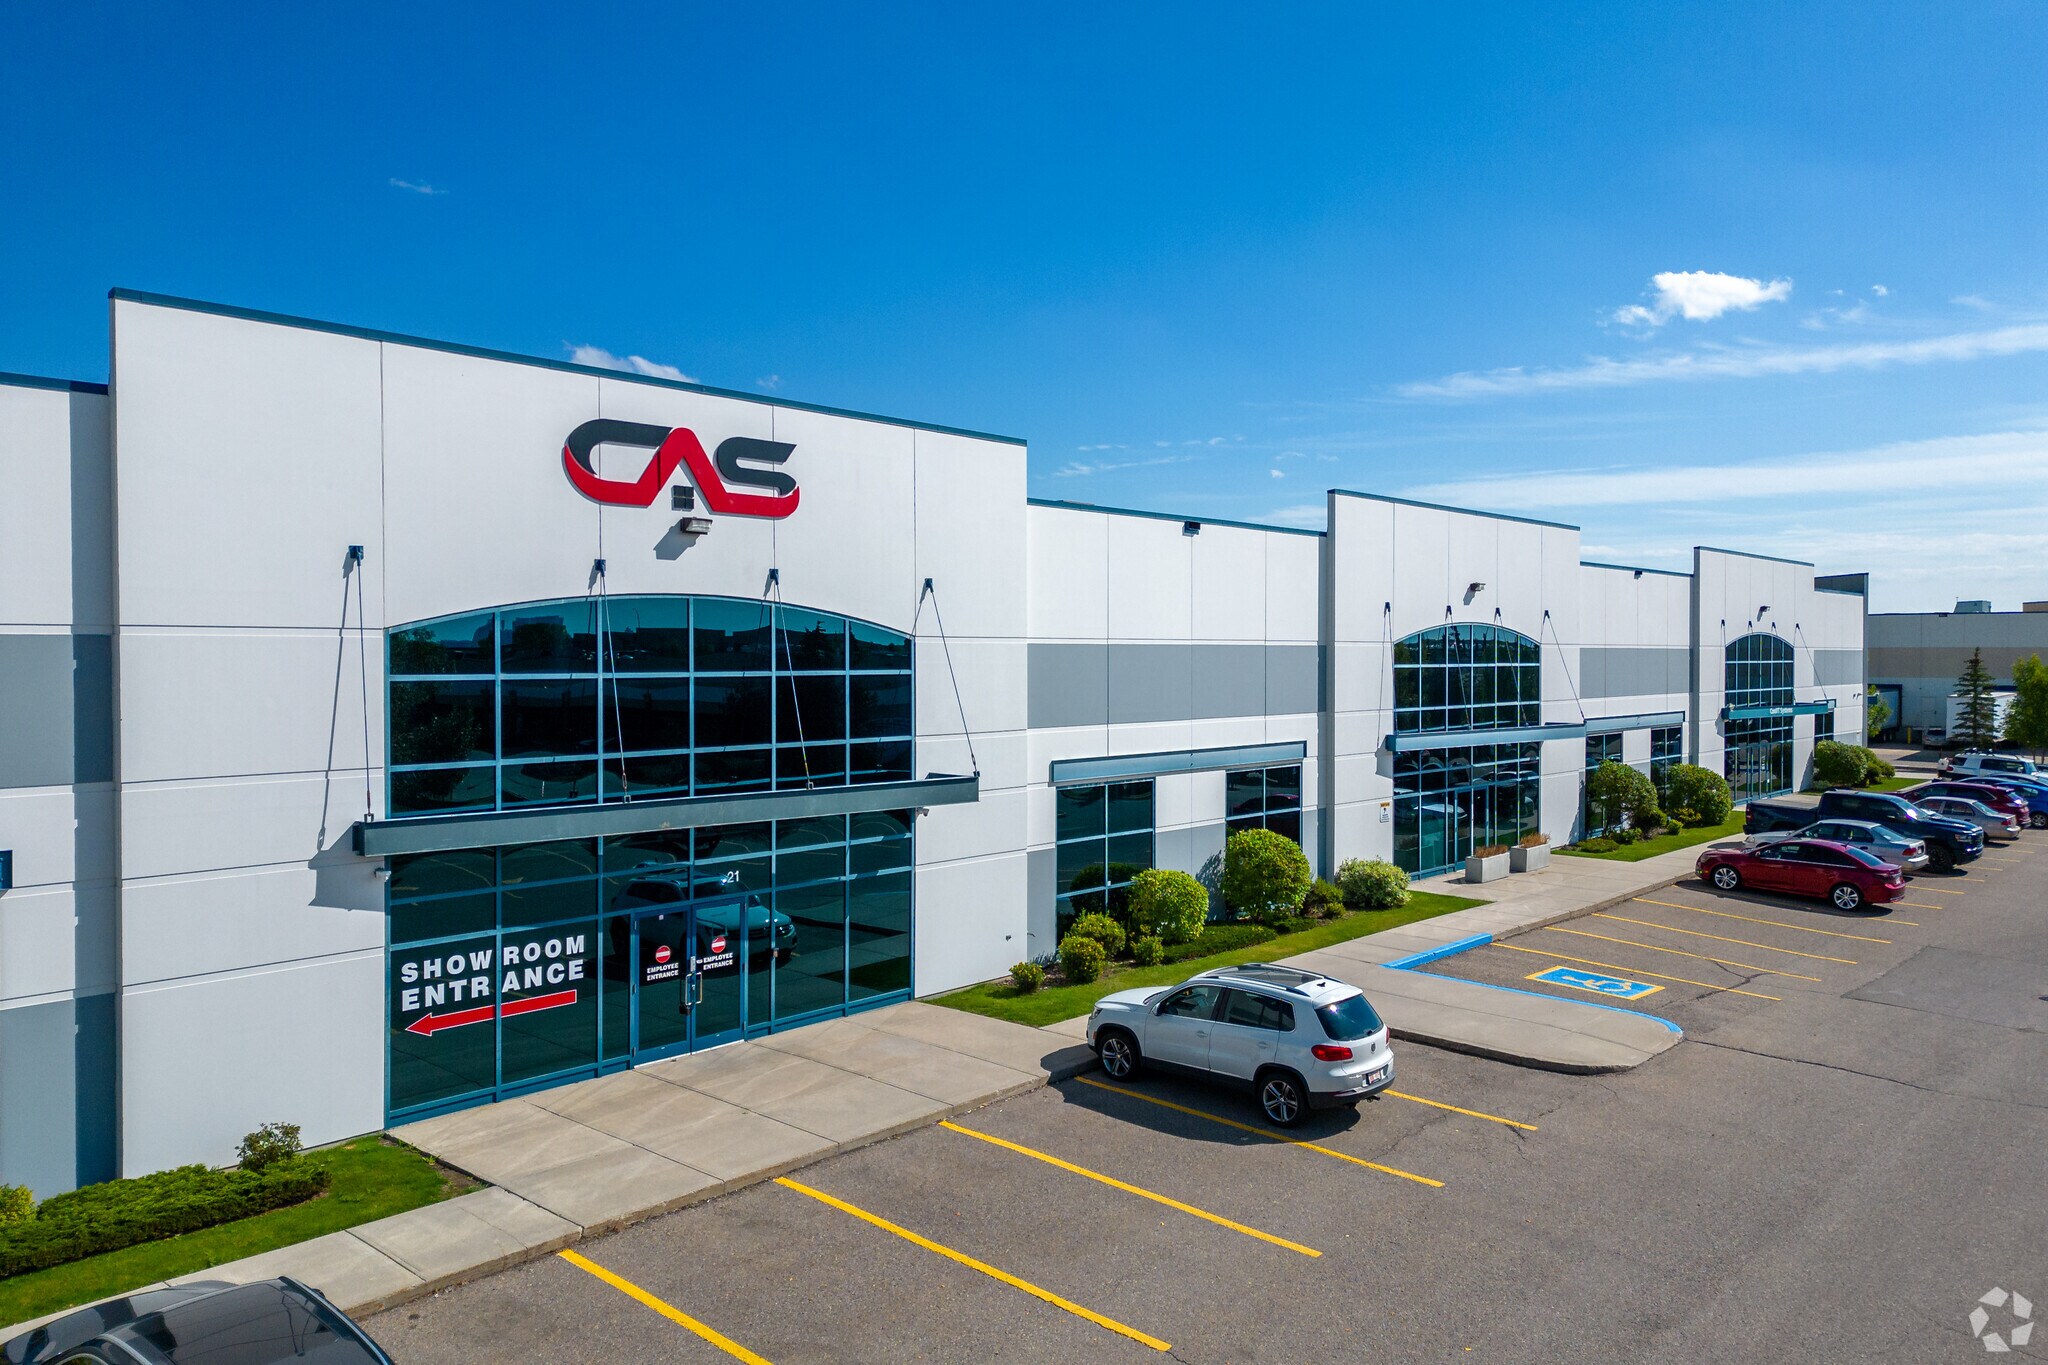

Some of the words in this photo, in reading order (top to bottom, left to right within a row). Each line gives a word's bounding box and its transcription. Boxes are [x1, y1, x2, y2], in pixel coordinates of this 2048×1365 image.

[562, 418, 800, 520] CAS
[727, 870, 740, 883] 21
[703, 952, 733, 963] EMPLOYEE
[646, 962, 679, 974] EMPLOYEE
[703, 959, 733, 970] ENTRANCE
[646, 970, 679, 981] ENTRANCE
[402, 959, 584, 1012] ENTRANCE
